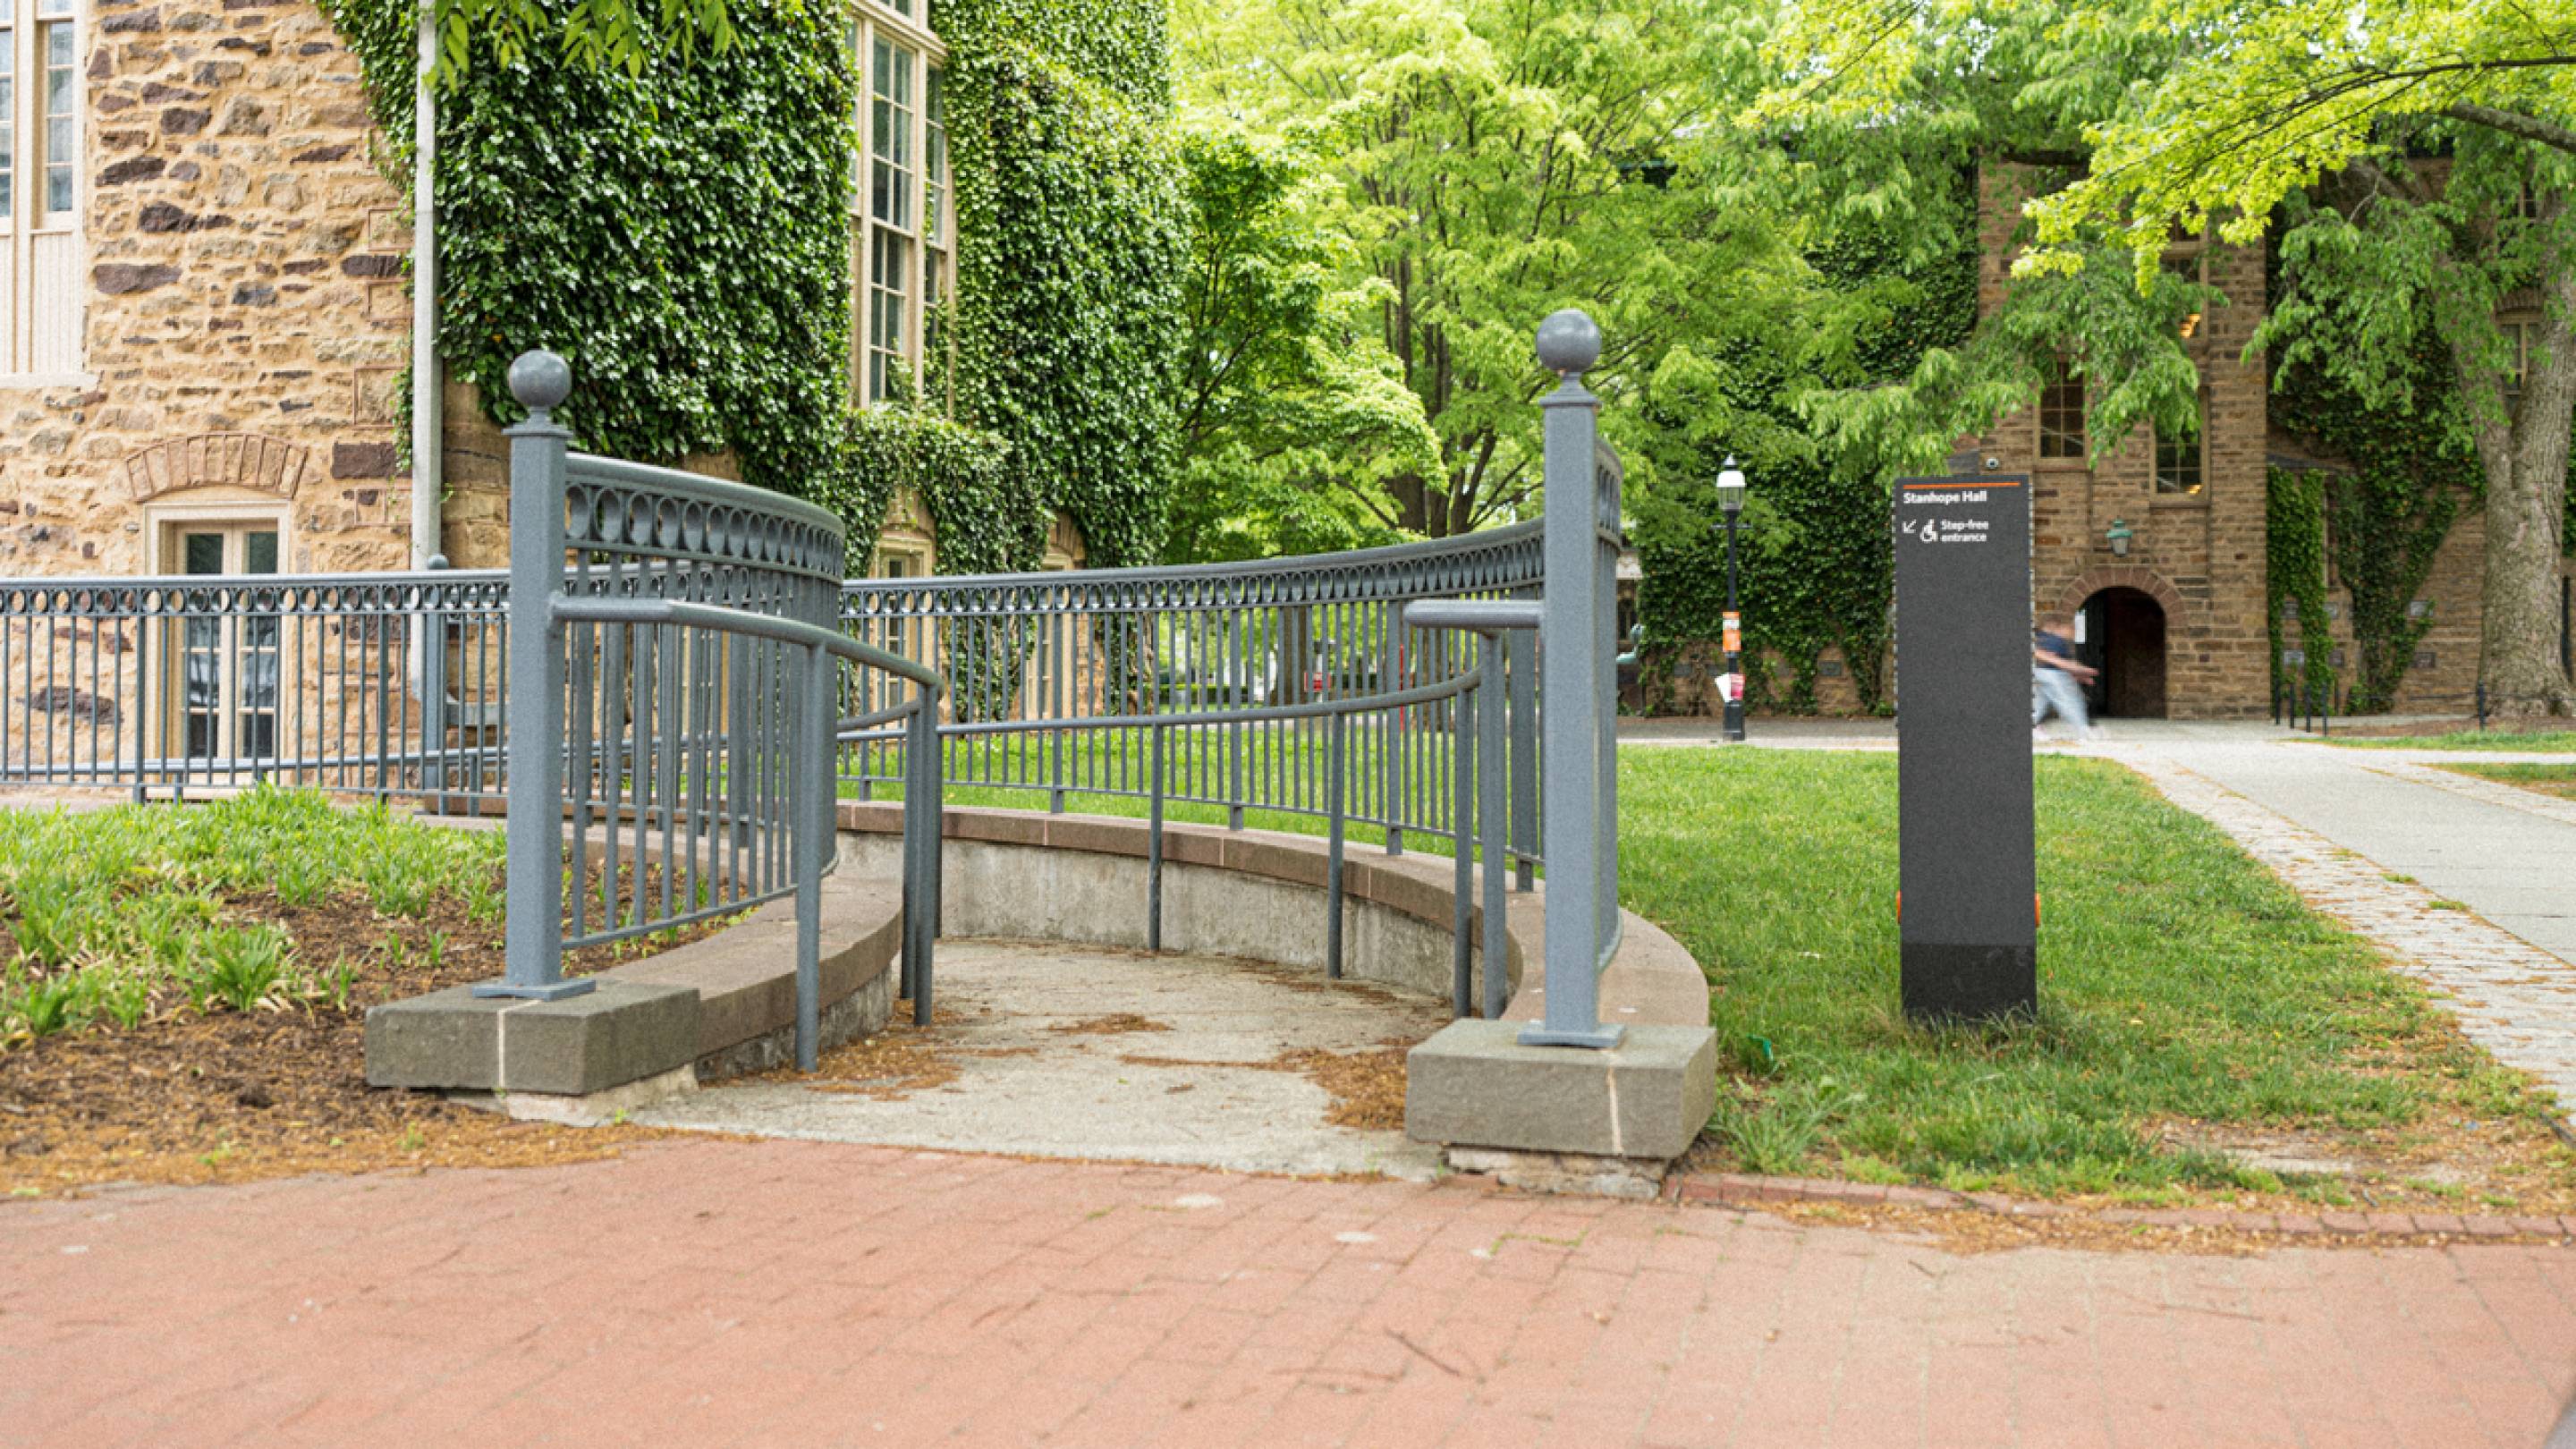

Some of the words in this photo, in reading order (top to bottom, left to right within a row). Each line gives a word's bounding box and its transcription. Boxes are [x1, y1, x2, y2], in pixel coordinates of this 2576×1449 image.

[1903, 492, 1960, 505] Stanhope
[1962, 490, 1987, 502] Hall
[1940, 519, 1989, 531] Step-free
[1940, 532, 1987, 542] entrance
